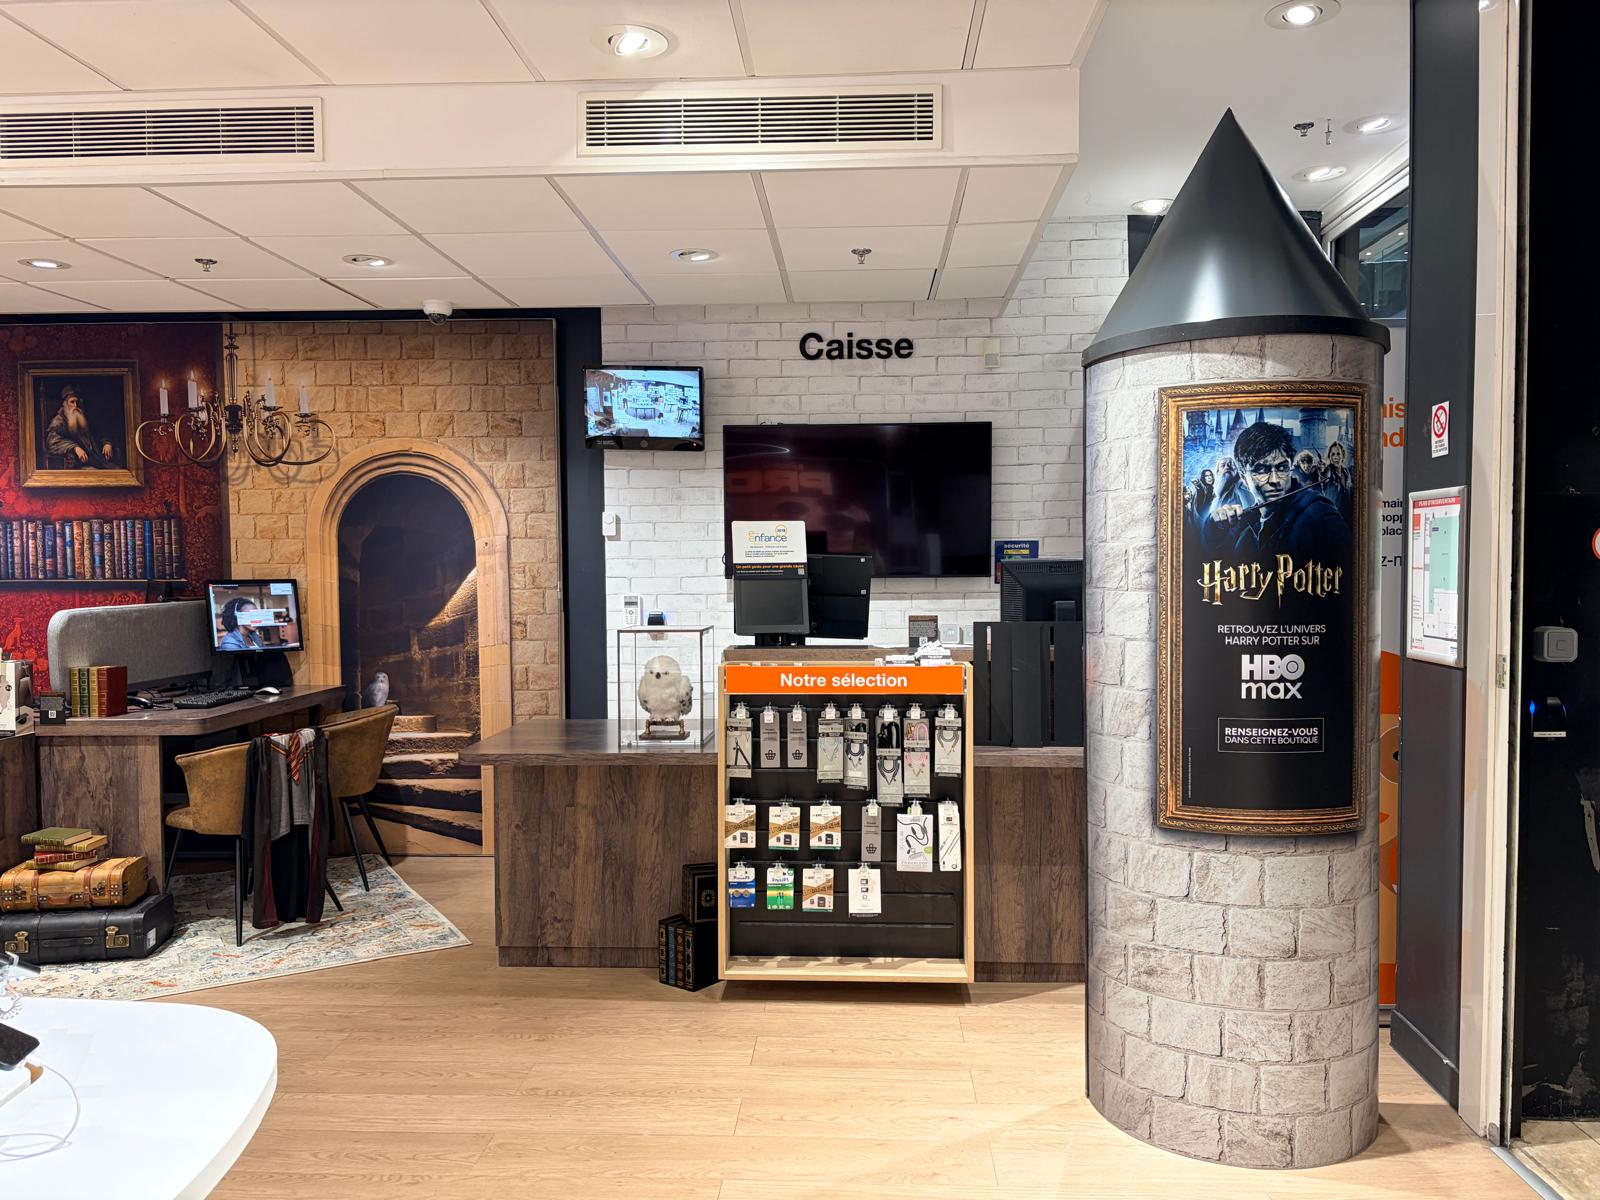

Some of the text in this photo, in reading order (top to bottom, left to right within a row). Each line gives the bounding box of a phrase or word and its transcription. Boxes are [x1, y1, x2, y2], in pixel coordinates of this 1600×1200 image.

[799, 332, 914, 360] Caisse
[1197, 553, 1343, 608] Harry Potter
[1217, 624, 1327, 634] RETROUVEZ L'UNIVERS
[1225, 635, 1320, 645] HARRY POTTER SUR
[1241, 654, 1305, 681] HBO
[780, 672, 908, 687] Notre sélection
[1241, 682, 1303, 699] max
[1225, 727, 1319, 736] RENSEIGNEZ-VOUS
[1225, 736, 1319, 745] DANS CETTE BOUTIQUE
